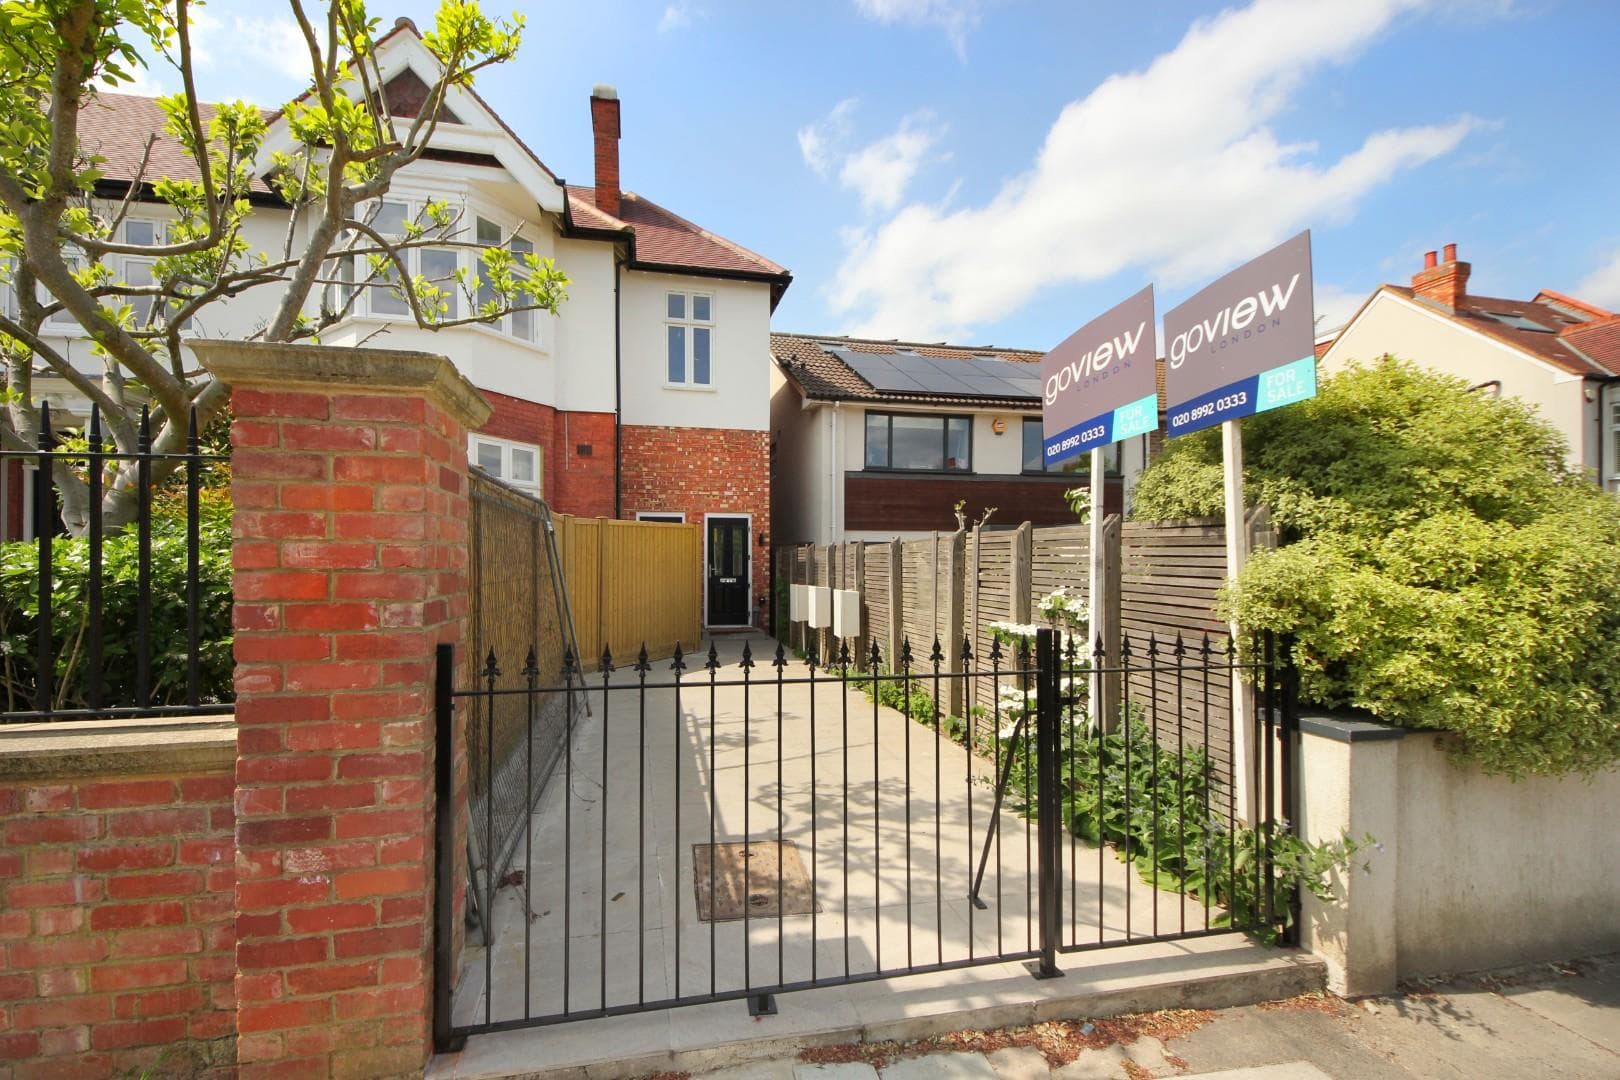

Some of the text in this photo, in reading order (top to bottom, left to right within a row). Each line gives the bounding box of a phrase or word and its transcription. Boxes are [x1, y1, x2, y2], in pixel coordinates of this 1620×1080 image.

[1211, 317, 1281, 354] LONDON
[1077, 361, 1132, 392] LONDON
[1266, 368, 1296, 386] FOR
[1267, 382, 1305, 403] SALE
[1120, 405, 1143, 421] FOR
[1172, 391, 1247, 427] 020 8992 0333
[1120, 416, 1149, 435] SALE
[1047, 425, 1105, 457] 020 8992 0333
